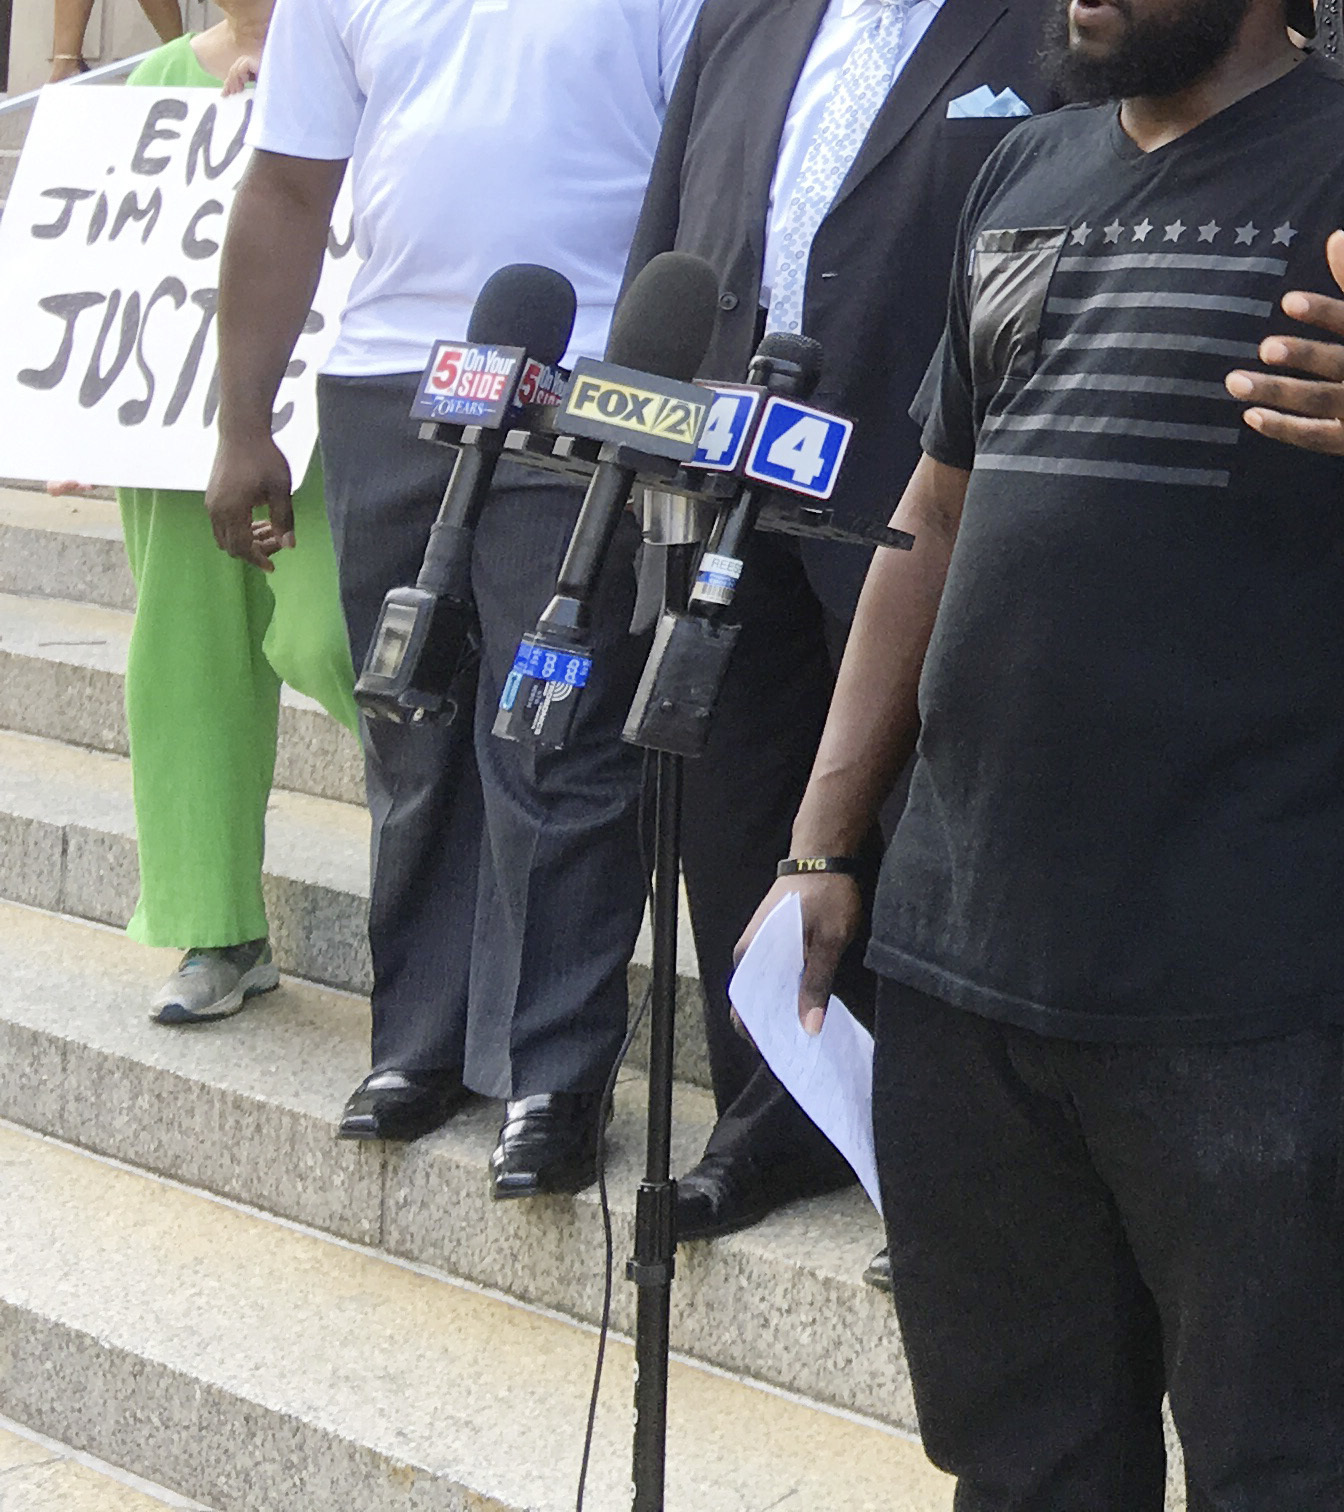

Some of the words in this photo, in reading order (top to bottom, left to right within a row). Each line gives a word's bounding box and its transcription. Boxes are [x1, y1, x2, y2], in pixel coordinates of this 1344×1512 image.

[30, 186, 163, 246] JIM
[432, 350, 463, 391] 5
[466, 348, 485, 372] On
[485, 349, 517, 376] Your
[458, 373, 506, 400] SIDE
[518, 364, 541, 405] 5
[450, 399, 485, 417] YEARS
[574, 382, 654, 427] FOX
[662, 406, 692, 437] 2
[698, 396, 740, 462] 4
[766, 416, 831, 486] 4
[796, 858, 827, 871] TYG
